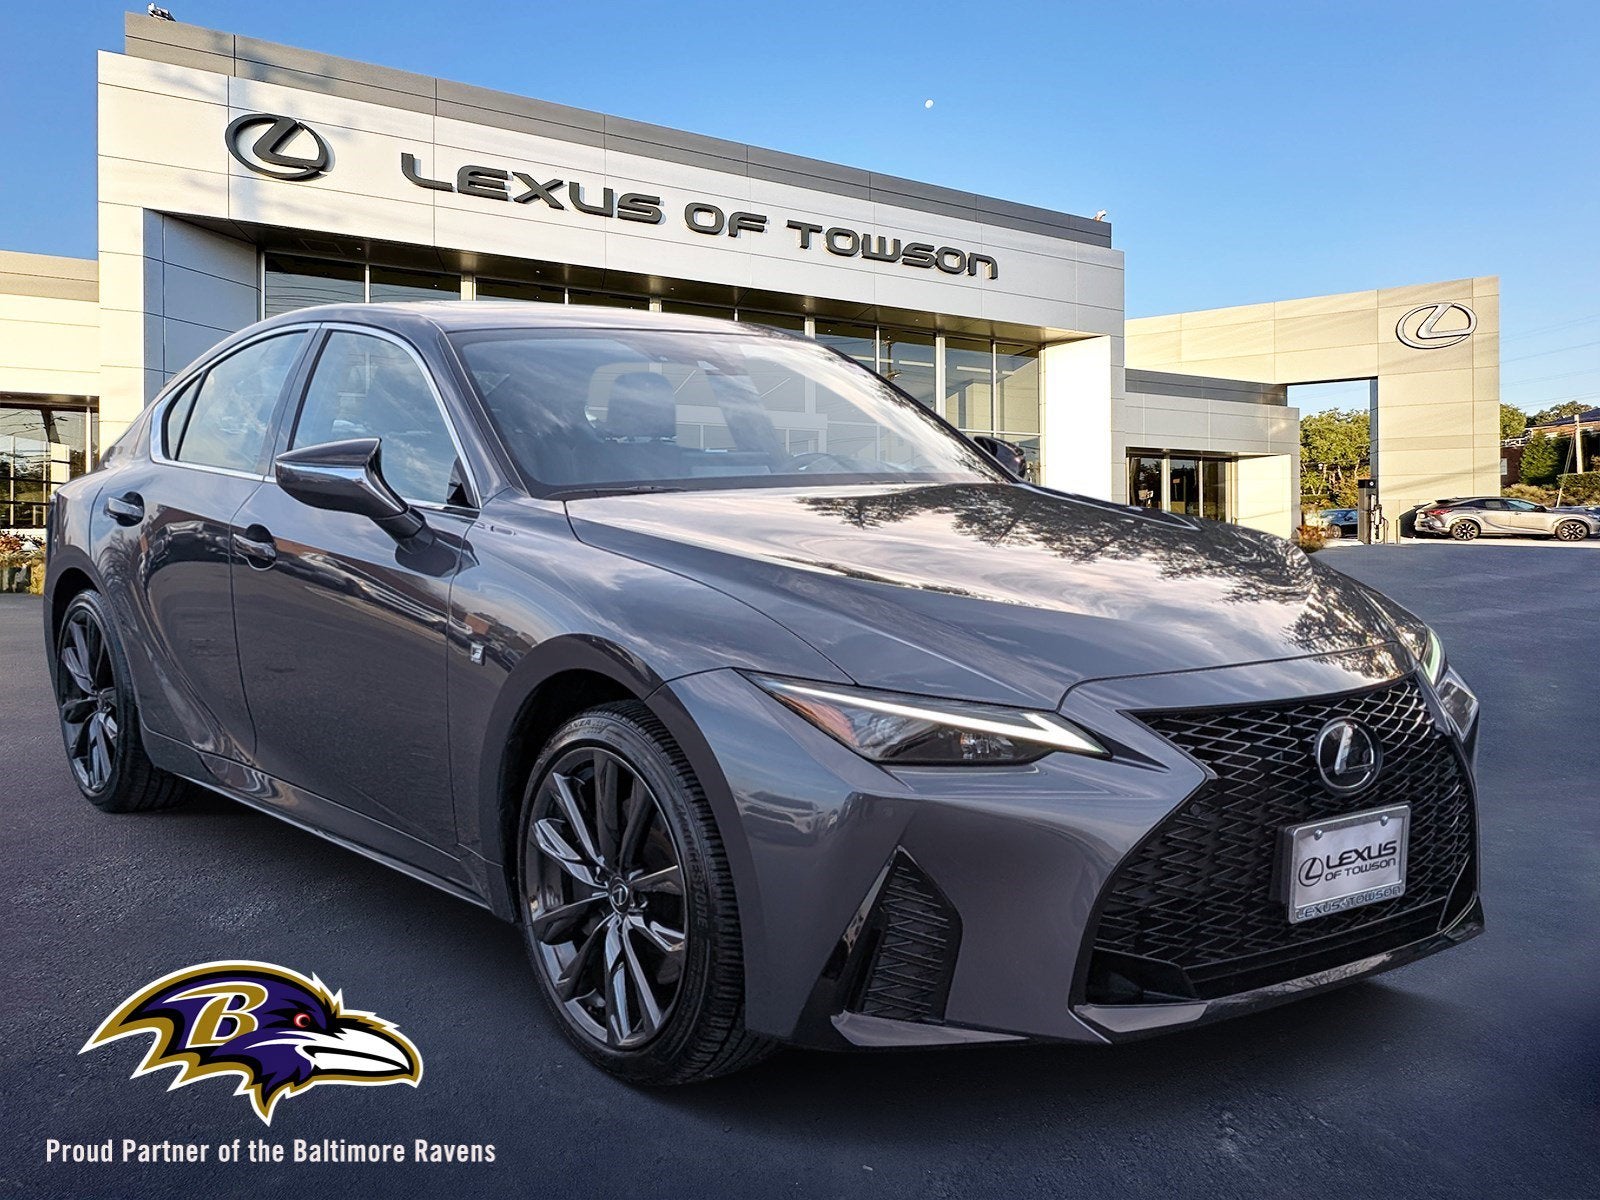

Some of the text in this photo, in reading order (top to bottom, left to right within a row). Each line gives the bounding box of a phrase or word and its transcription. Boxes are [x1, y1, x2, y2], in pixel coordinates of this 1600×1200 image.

[401, 152, 999, 281] LEXUS OF TOWSON
[1326, 840, 1397, 870] LEXUS
[1325, 858, 1396, 881] OF TOWSON
[1296, 902, 1340, 920] LEXUS
